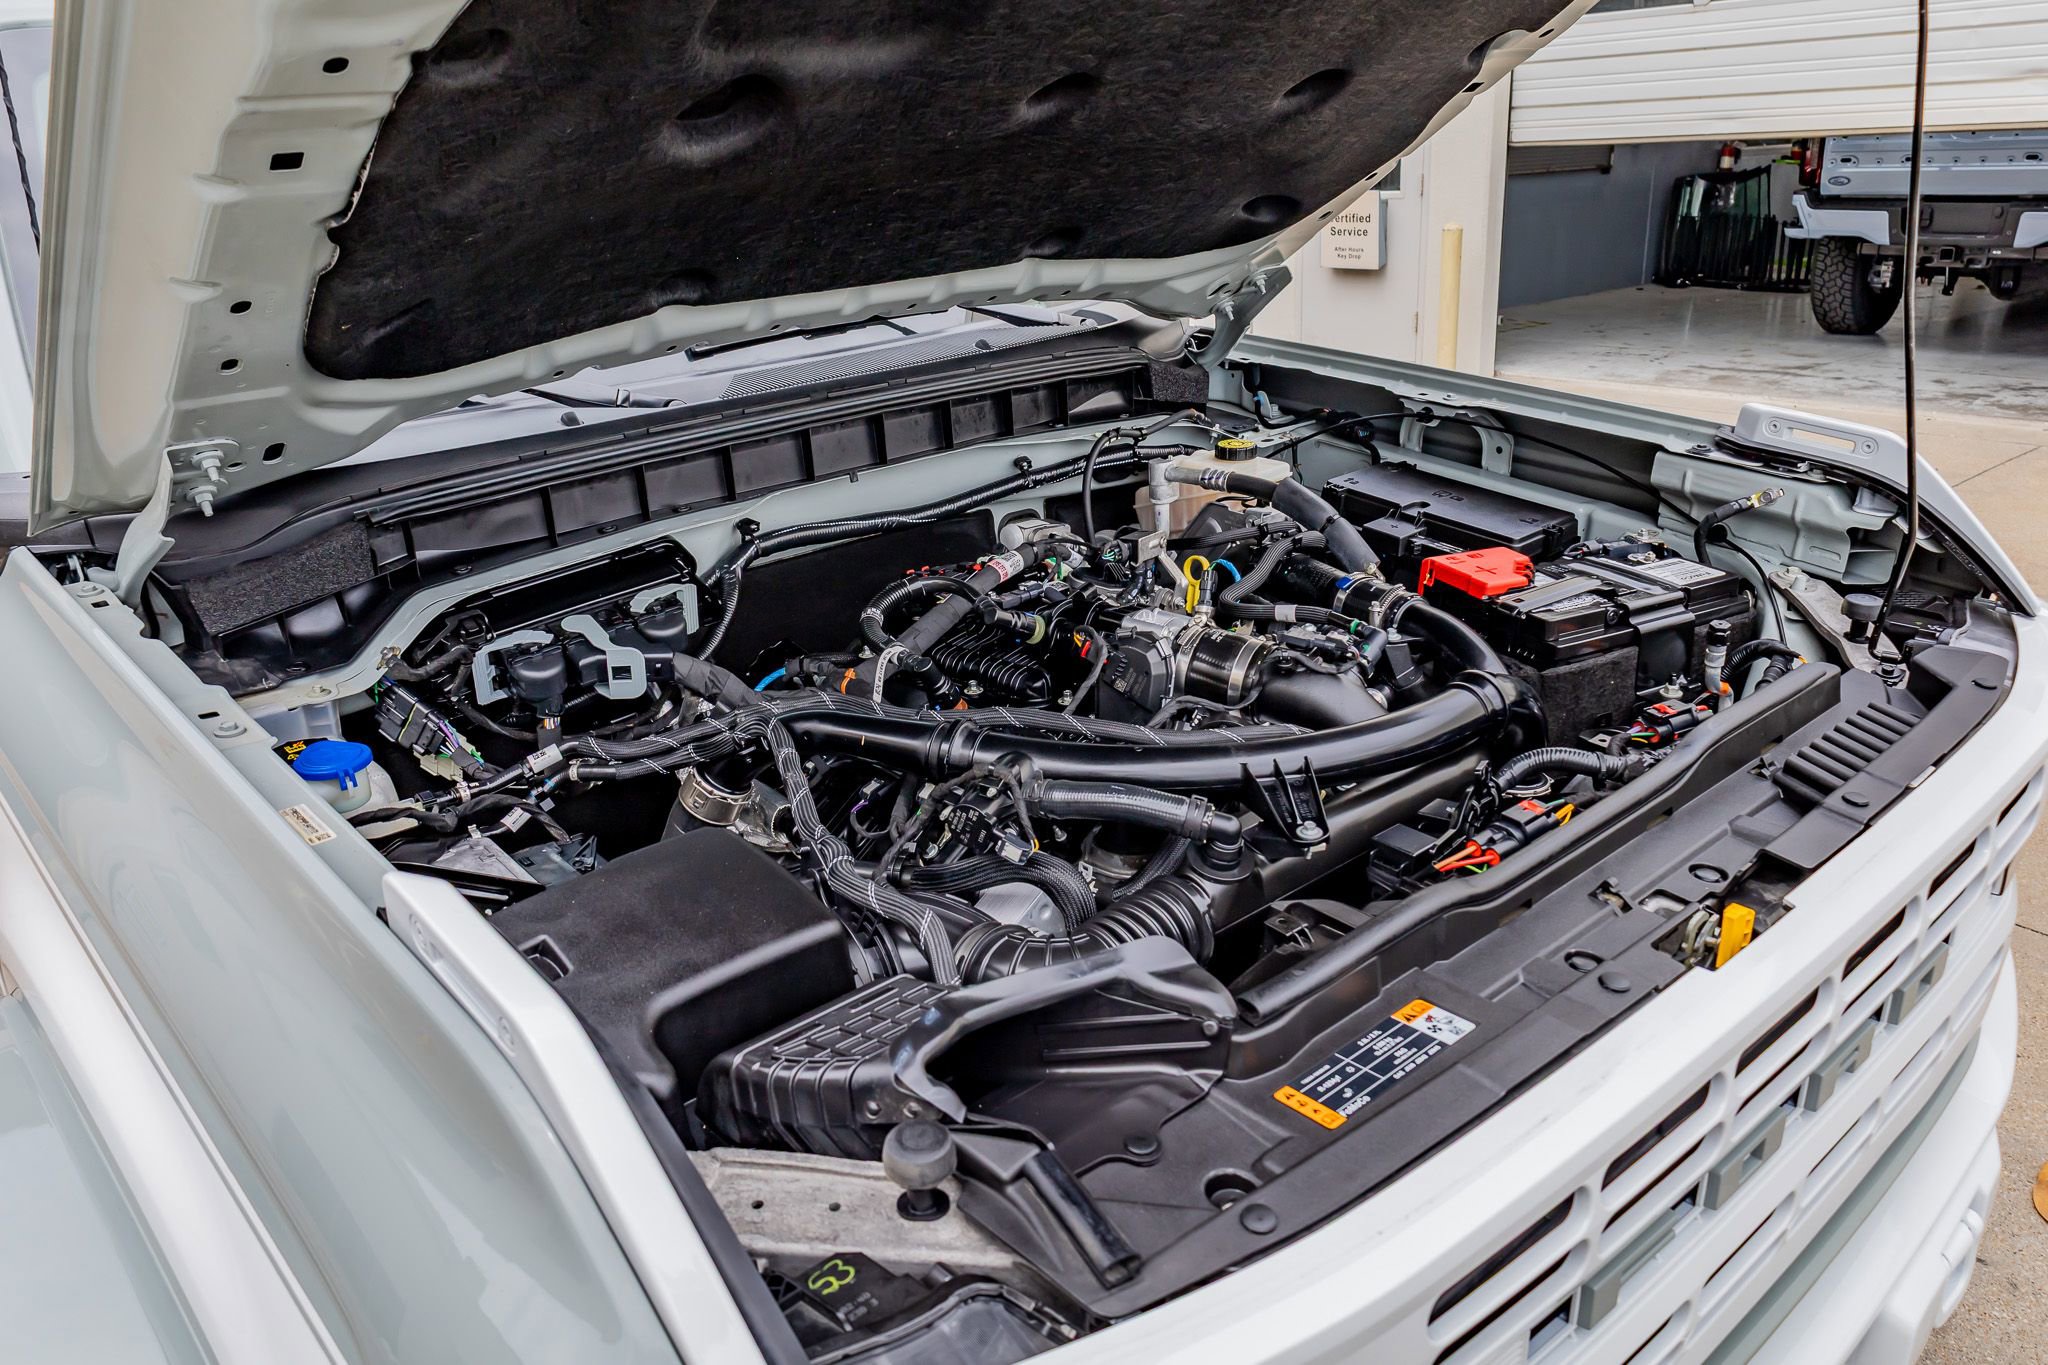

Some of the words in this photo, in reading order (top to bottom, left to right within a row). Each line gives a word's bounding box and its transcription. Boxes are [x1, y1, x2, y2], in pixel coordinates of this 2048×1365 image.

[1331, 213, 1371, 223] ertified
[1330, 226, 1368, 237] Service
[1578, 942, 1949, 1330] FORD
